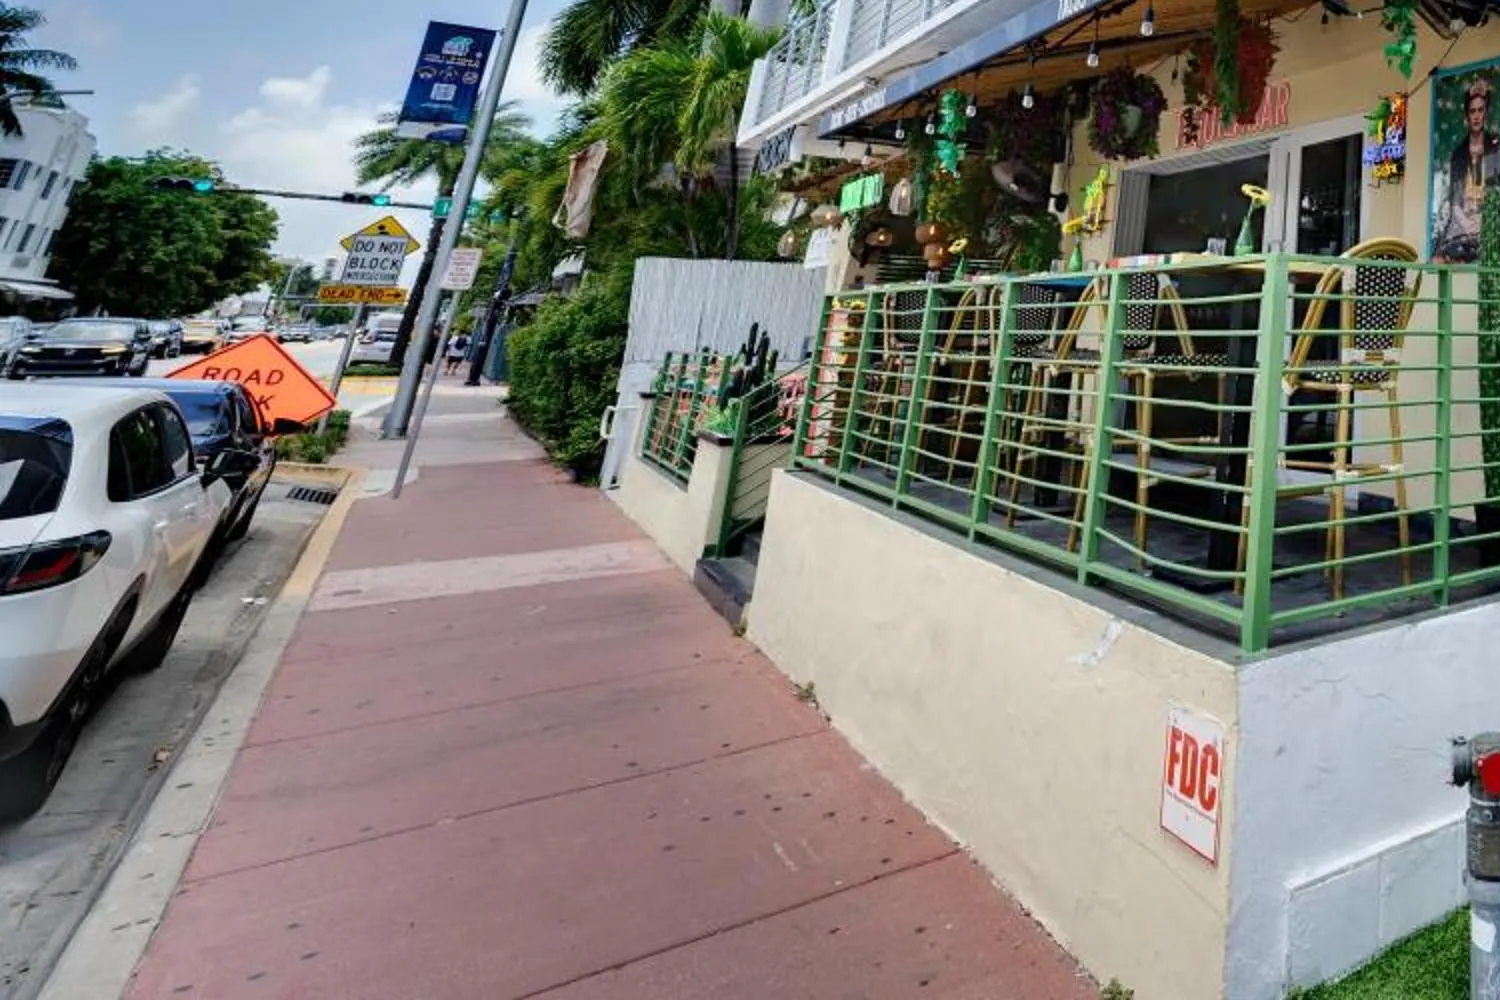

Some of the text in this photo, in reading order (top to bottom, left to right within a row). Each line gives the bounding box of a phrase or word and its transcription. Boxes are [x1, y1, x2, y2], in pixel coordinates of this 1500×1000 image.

[354, 240, 404, 255] DO NOT
[349, 257, 401, 270] BLOCK
[201, 367, 285, 385] ROAD
[1167, 726, 1218, 812] FDC
